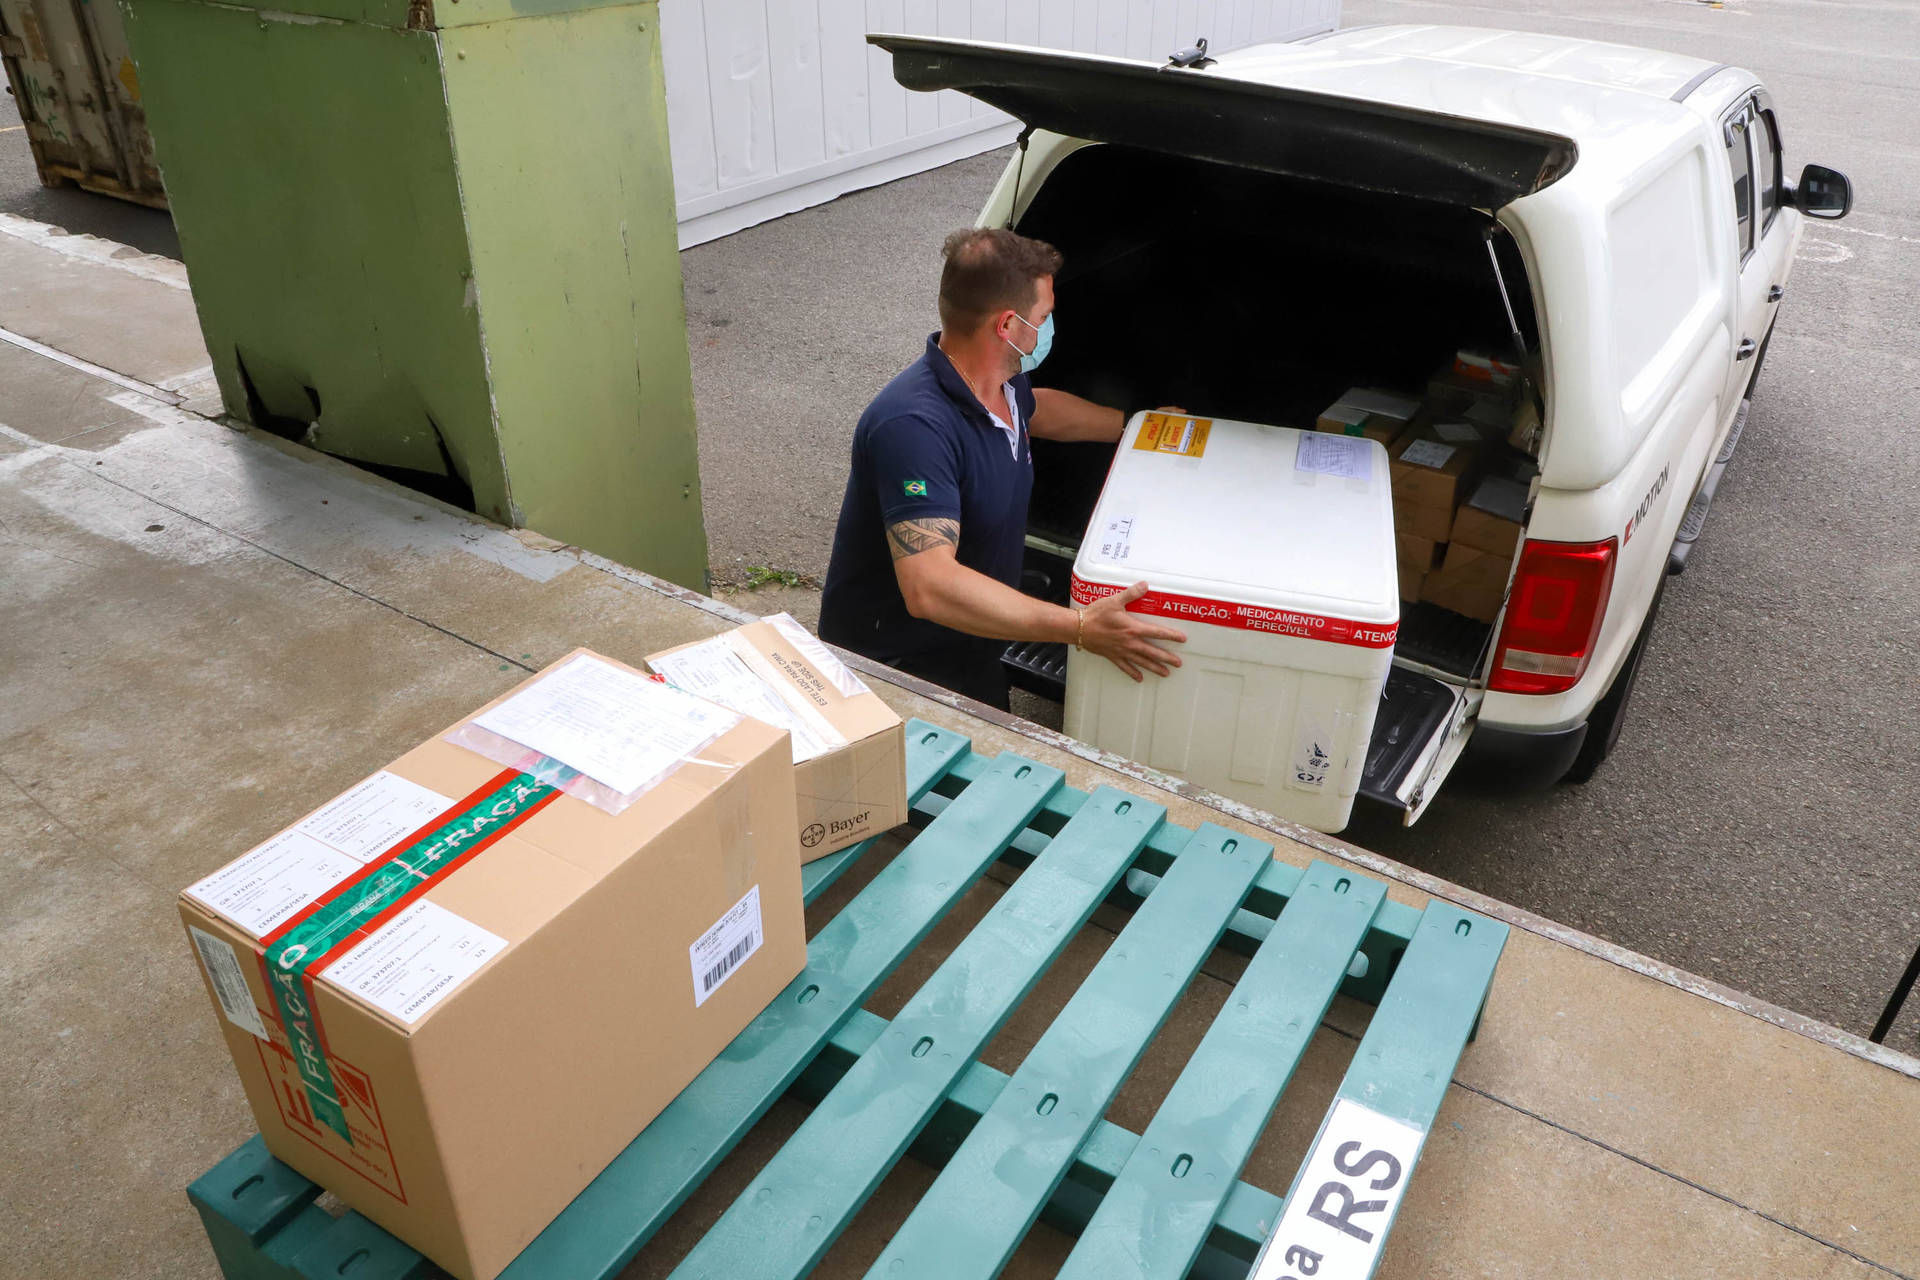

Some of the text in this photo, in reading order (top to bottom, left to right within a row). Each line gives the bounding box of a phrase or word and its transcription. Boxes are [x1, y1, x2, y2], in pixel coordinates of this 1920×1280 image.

[1071, 575, 1121, 597] DICAMEN
[1162, 600, 1231, 619] ATENÇÃO:
[1236, 606, 1326, 628] MEDICAMENTO
[1246, 618, 1312, 637] PERECÍVEL
[784, 664, 800, 679] PARA
[798, 667, 815, 680] SIDE
[797, 678, 814, 693] LADO
[810, 679, 825, 692] THIS
[830, 811, 870, 834] Bayer
[403, 974, 455, 1015] CEMEPAR/SESA
[273, 944, 325, 1081] FRAÇÃO
[1307, 1140, 1401, 1244] RS
